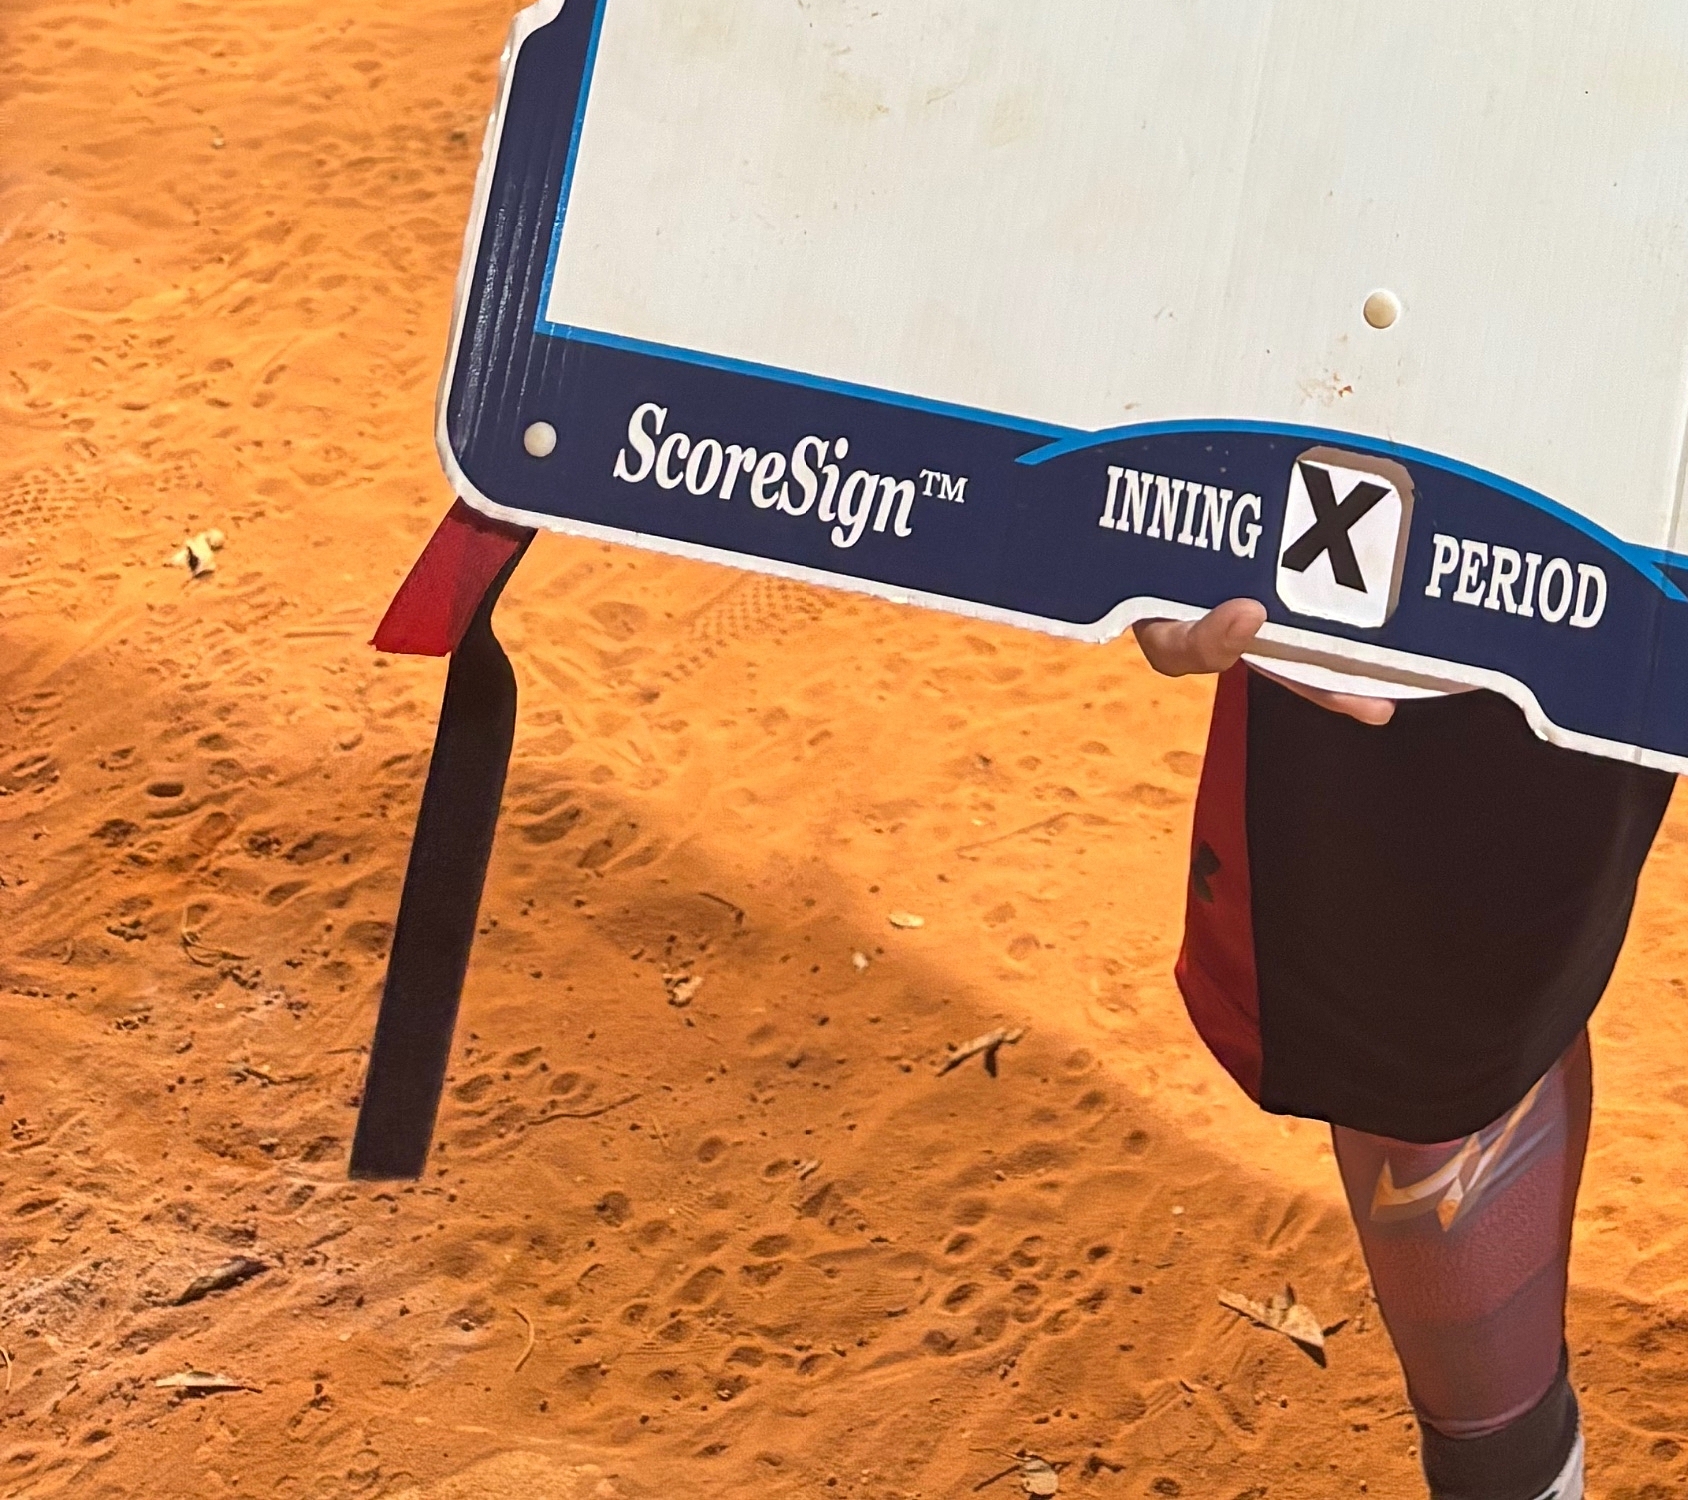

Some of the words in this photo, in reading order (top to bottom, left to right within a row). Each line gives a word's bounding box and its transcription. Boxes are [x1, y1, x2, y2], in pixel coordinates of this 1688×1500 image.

[1098, 465, 1263, 559] INNING
[1280, 460, 1391, 594] X
[1424, 533, 1608, 629] PERIOD
